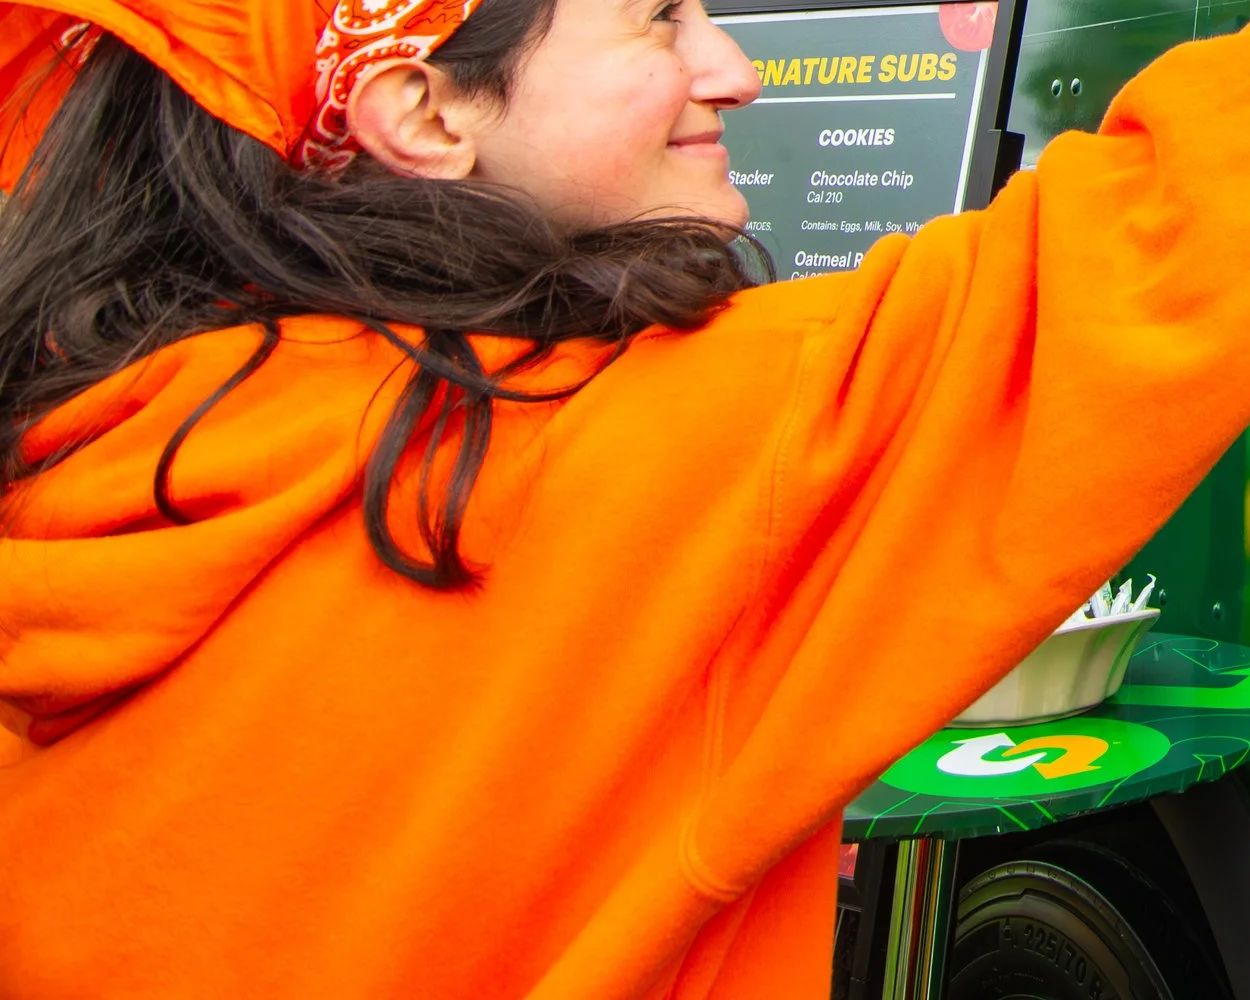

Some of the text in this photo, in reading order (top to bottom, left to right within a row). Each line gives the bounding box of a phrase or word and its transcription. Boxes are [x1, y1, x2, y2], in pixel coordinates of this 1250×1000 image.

[753, 53, 957, 86] GNATURE SUBS
[818, 128, 895, 147] COOKIES
[728, 169, 774, 185] Stacker
[810, 171, 913, 188] Chocolate Chip
[807, 191, 843, 203] Cal 210
[801, 220, 839, 231] Contains:
[840, 221, 862, 233] Eggs,
[865, 221, 883, 232] Milk,
[886, 221, 903, 233] Soy,
[795, 251, 852, 267] Oatmeal
